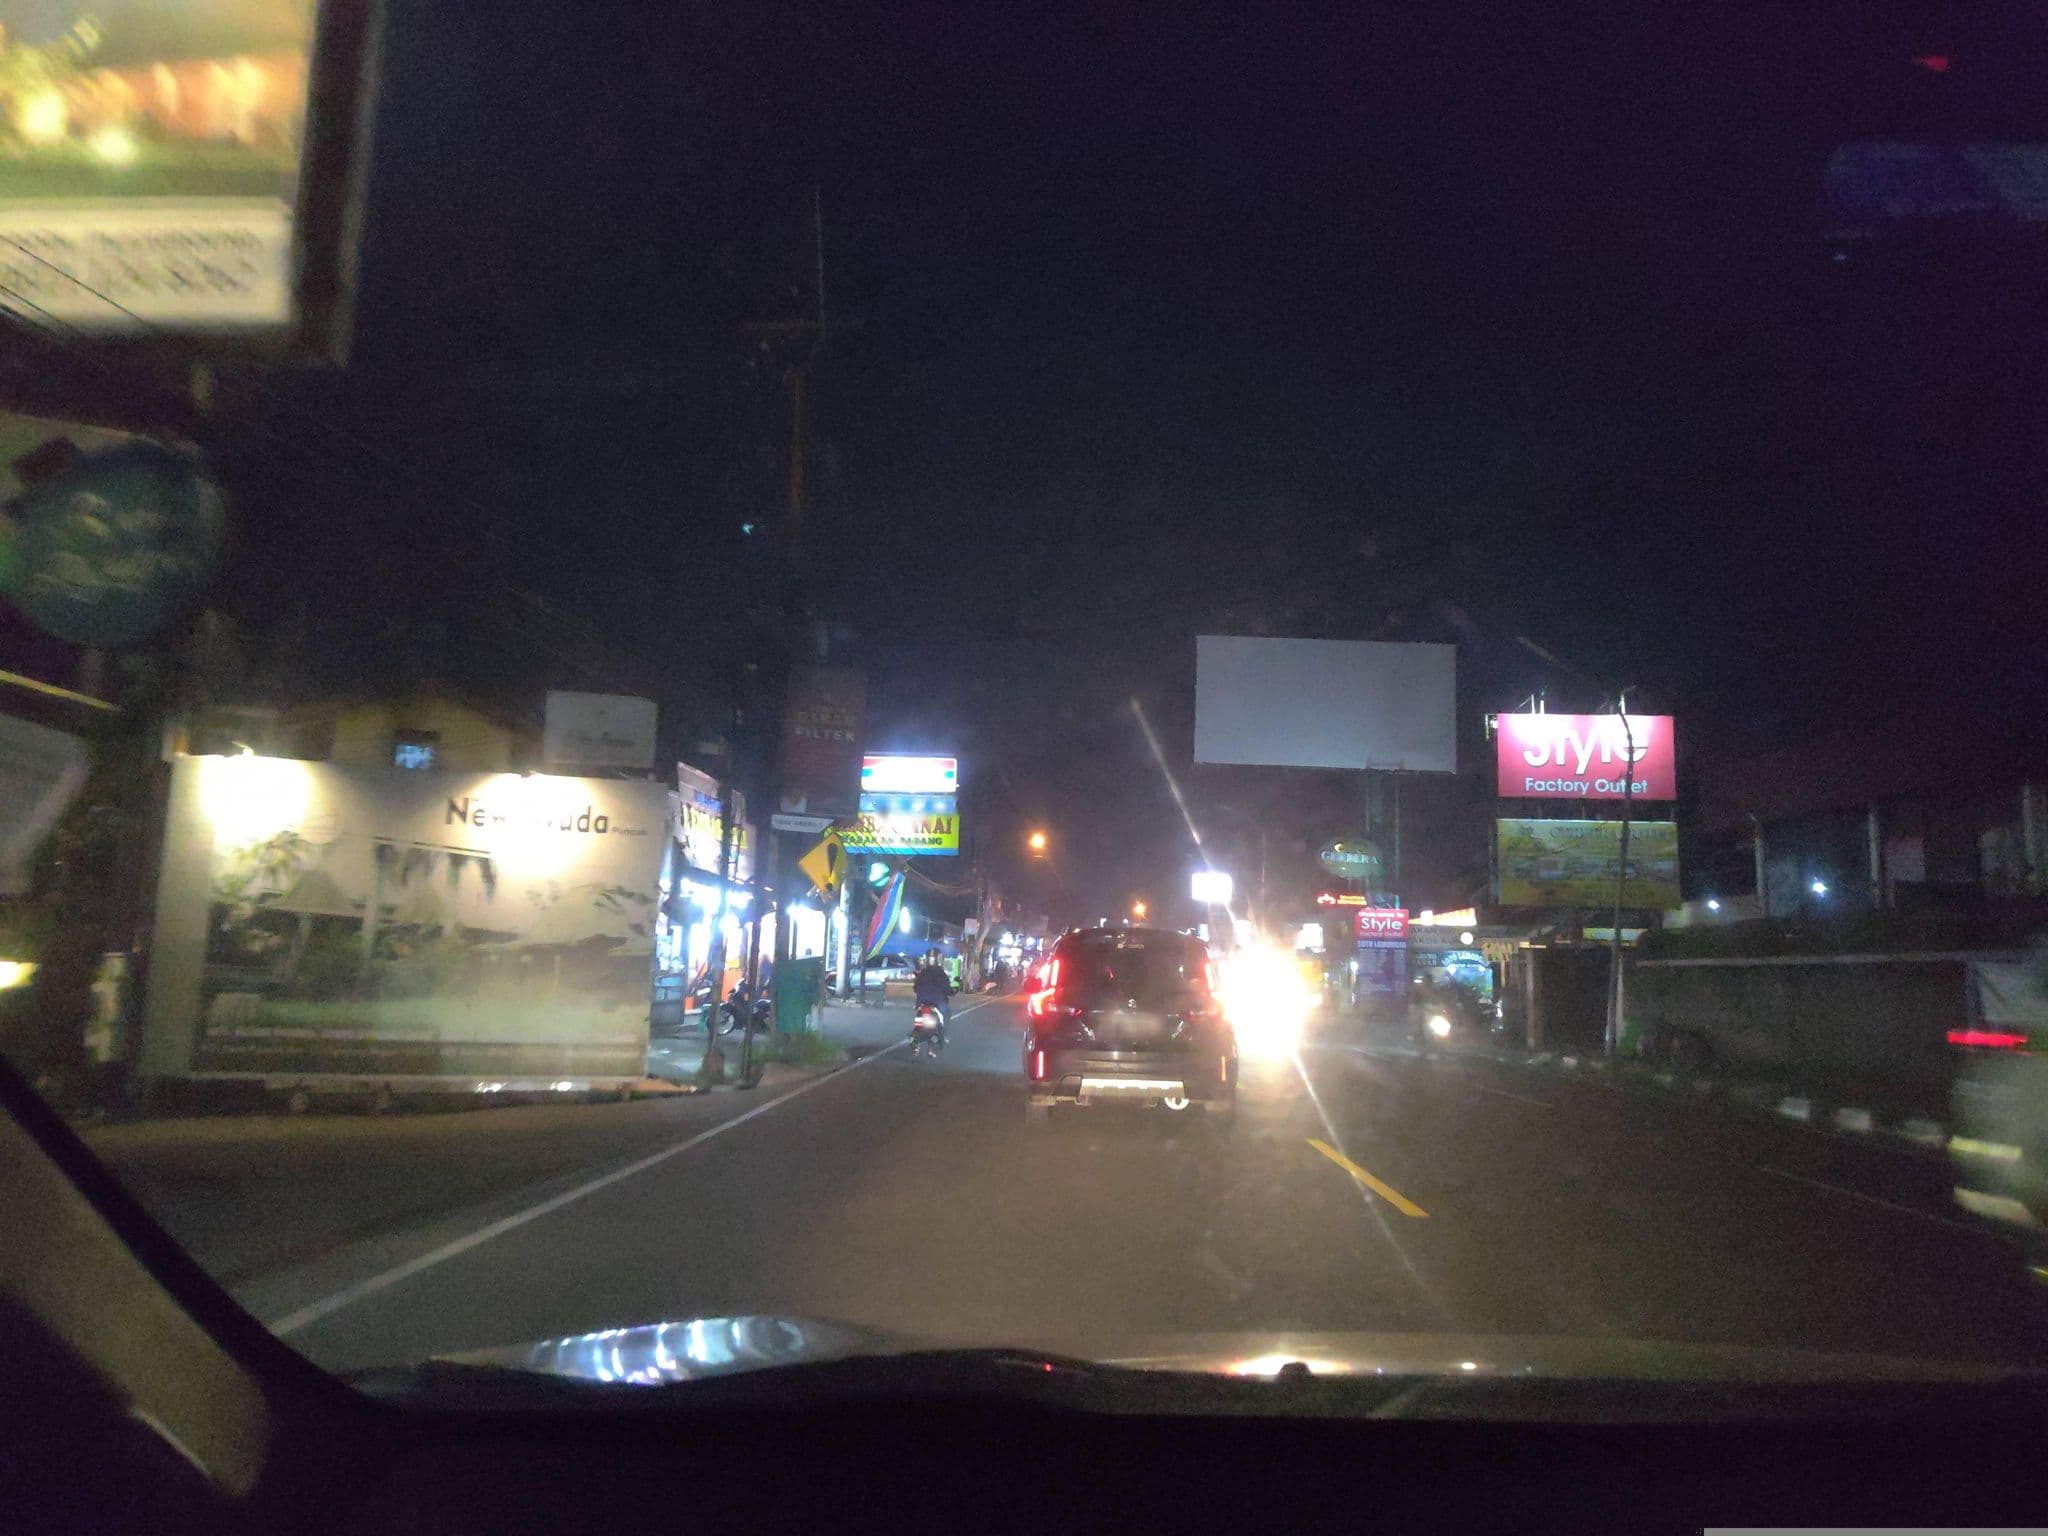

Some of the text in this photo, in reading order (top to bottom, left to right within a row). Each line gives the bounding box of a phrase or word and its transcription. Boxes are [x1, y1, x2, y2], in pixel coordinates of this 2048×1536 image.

[1522, 719, 1649, 774] Style
[1525, 777, 1649, 795] Factory Outet
[1360, 917, 1403, 932] Style
